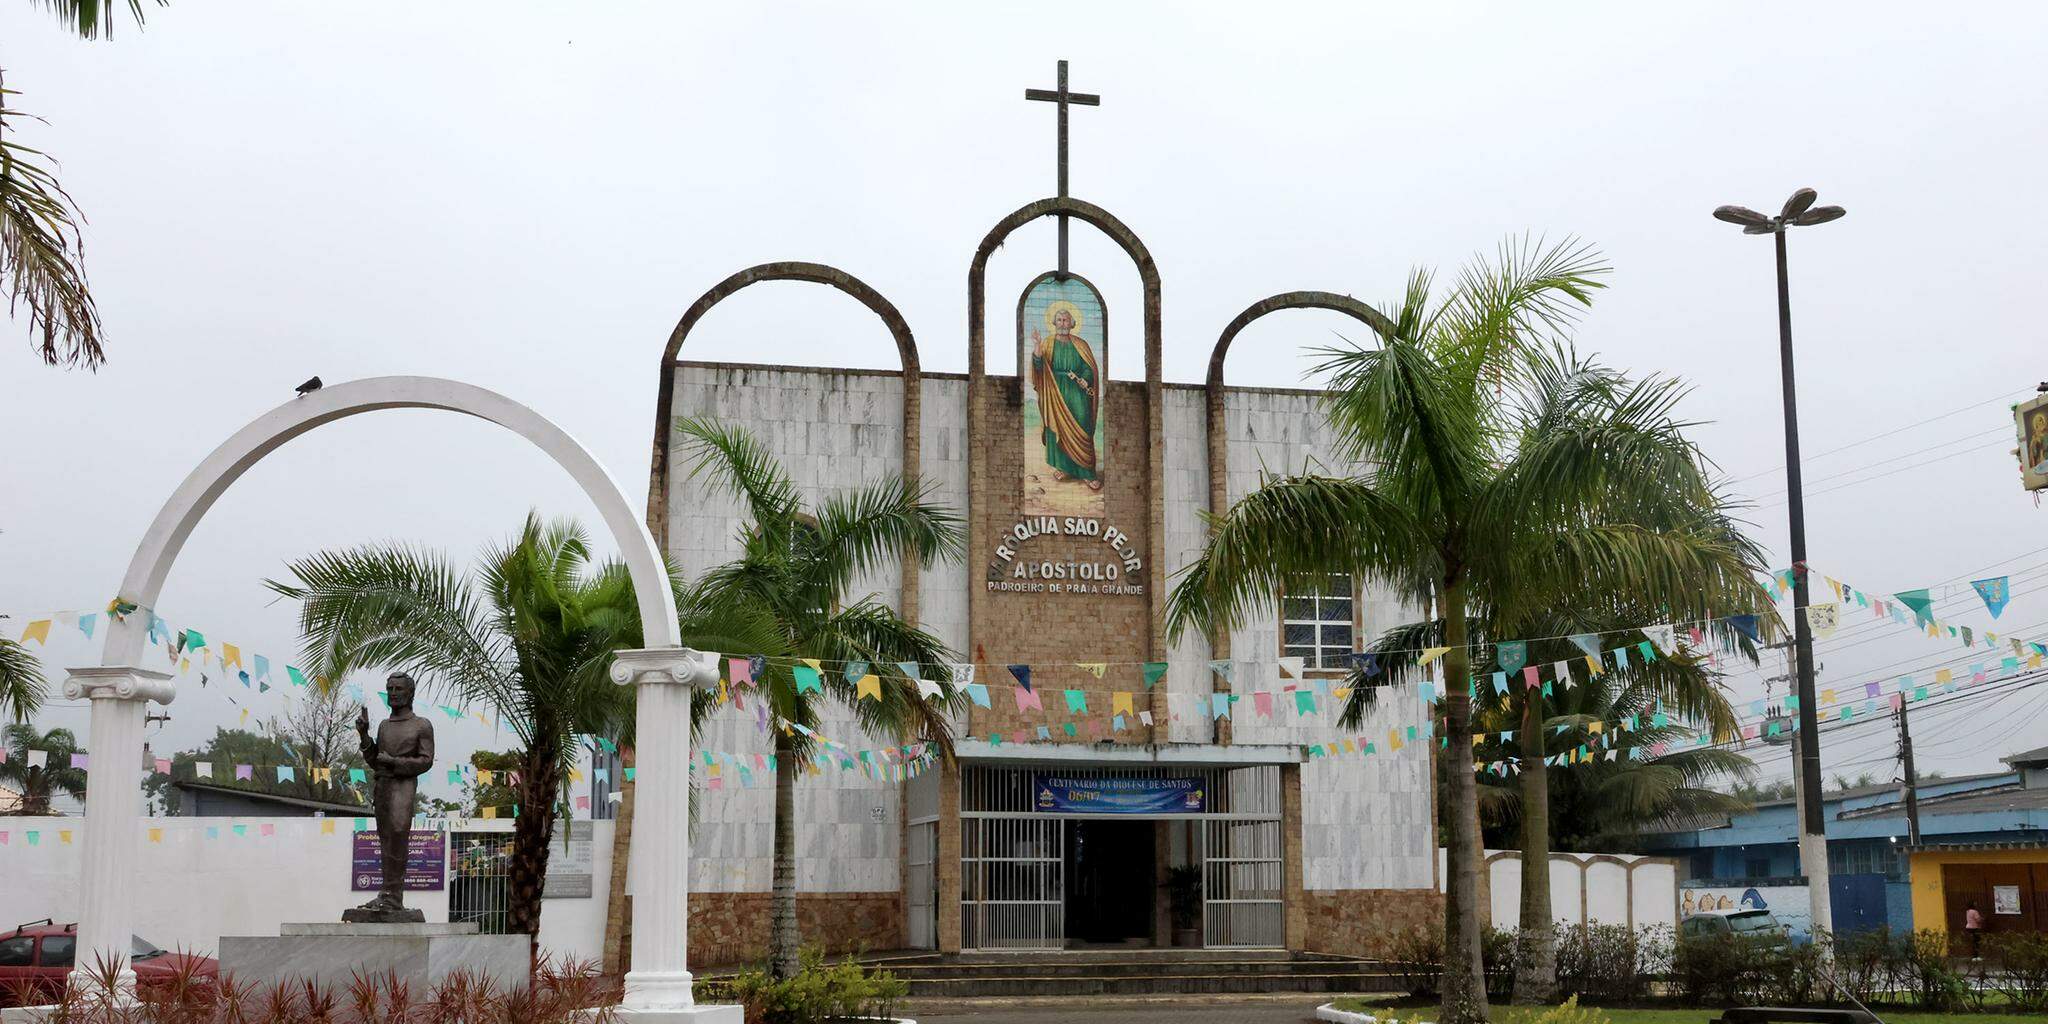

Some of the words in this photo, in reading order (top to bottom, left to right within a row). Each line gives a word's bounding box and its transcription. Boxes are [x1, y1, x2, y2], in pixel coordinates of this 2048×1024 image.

[1064, 515, 1099, 536] SÃO
[988, 582, 1044, 592] PADROEIRO
[1050, 583, 1061, 592] DE
[1067, 584, 1098, 594] PRAIA
[1102, 585, 1143, 595] GRANDE
[1100, 779, 1111, 789] DA
[1113, 779, 1147, 789] DIOCESE
[1149, 780, 1159, 789] DE
[1161, 779, 1192, 789] SANTOS
